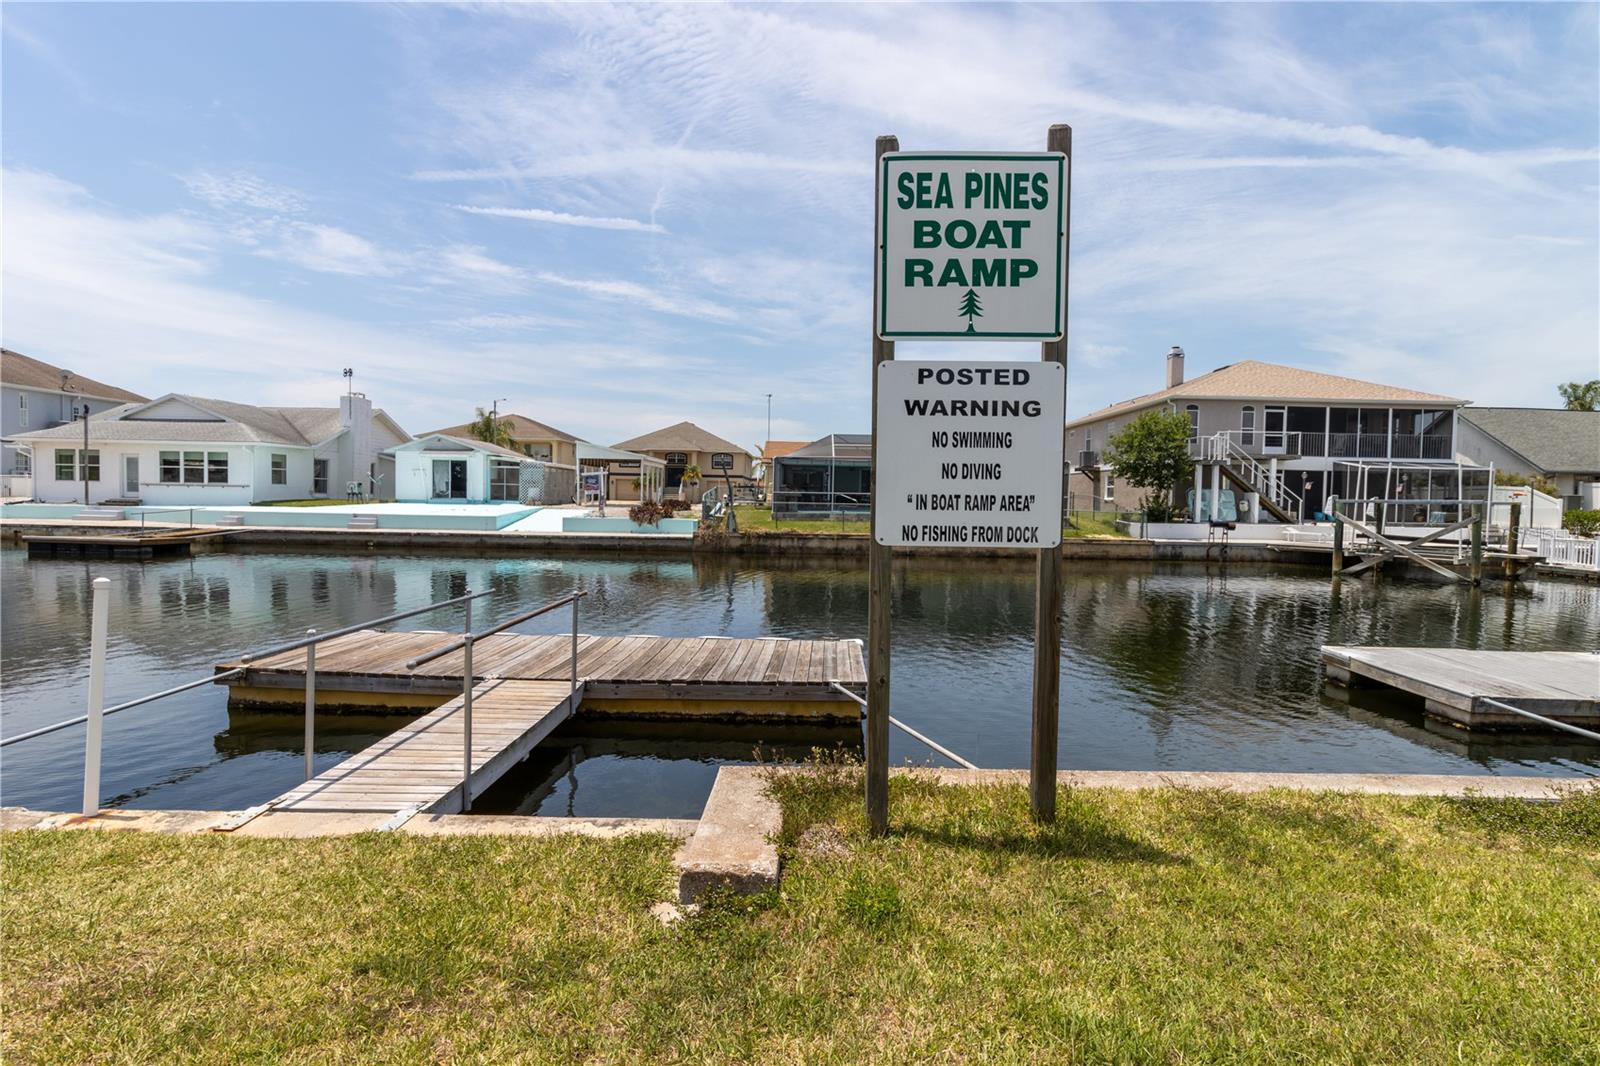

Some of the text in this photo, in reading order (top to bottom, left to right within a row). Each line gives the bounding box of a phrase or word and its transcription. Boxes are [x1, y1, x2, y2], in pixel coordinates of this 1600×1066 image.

[897, 171, 1049, 210] SEA PINES
[913, 219, 1031, 249] BOAT
[904, 258, 1039, 287] RAMP
[917, 367, 1030, 385] POSTED
[904, 399, 1041, 417] WARNING
[932, 431, 1012, 449] NO SWIMMING
[941, 463, 1002, 480] NO DIVING
[931, 494, 961, 511] BOAT
[964, 494, 997, 511] RAMP
[902, 525, 1039, 543] NO FISHING FROM DOCK
